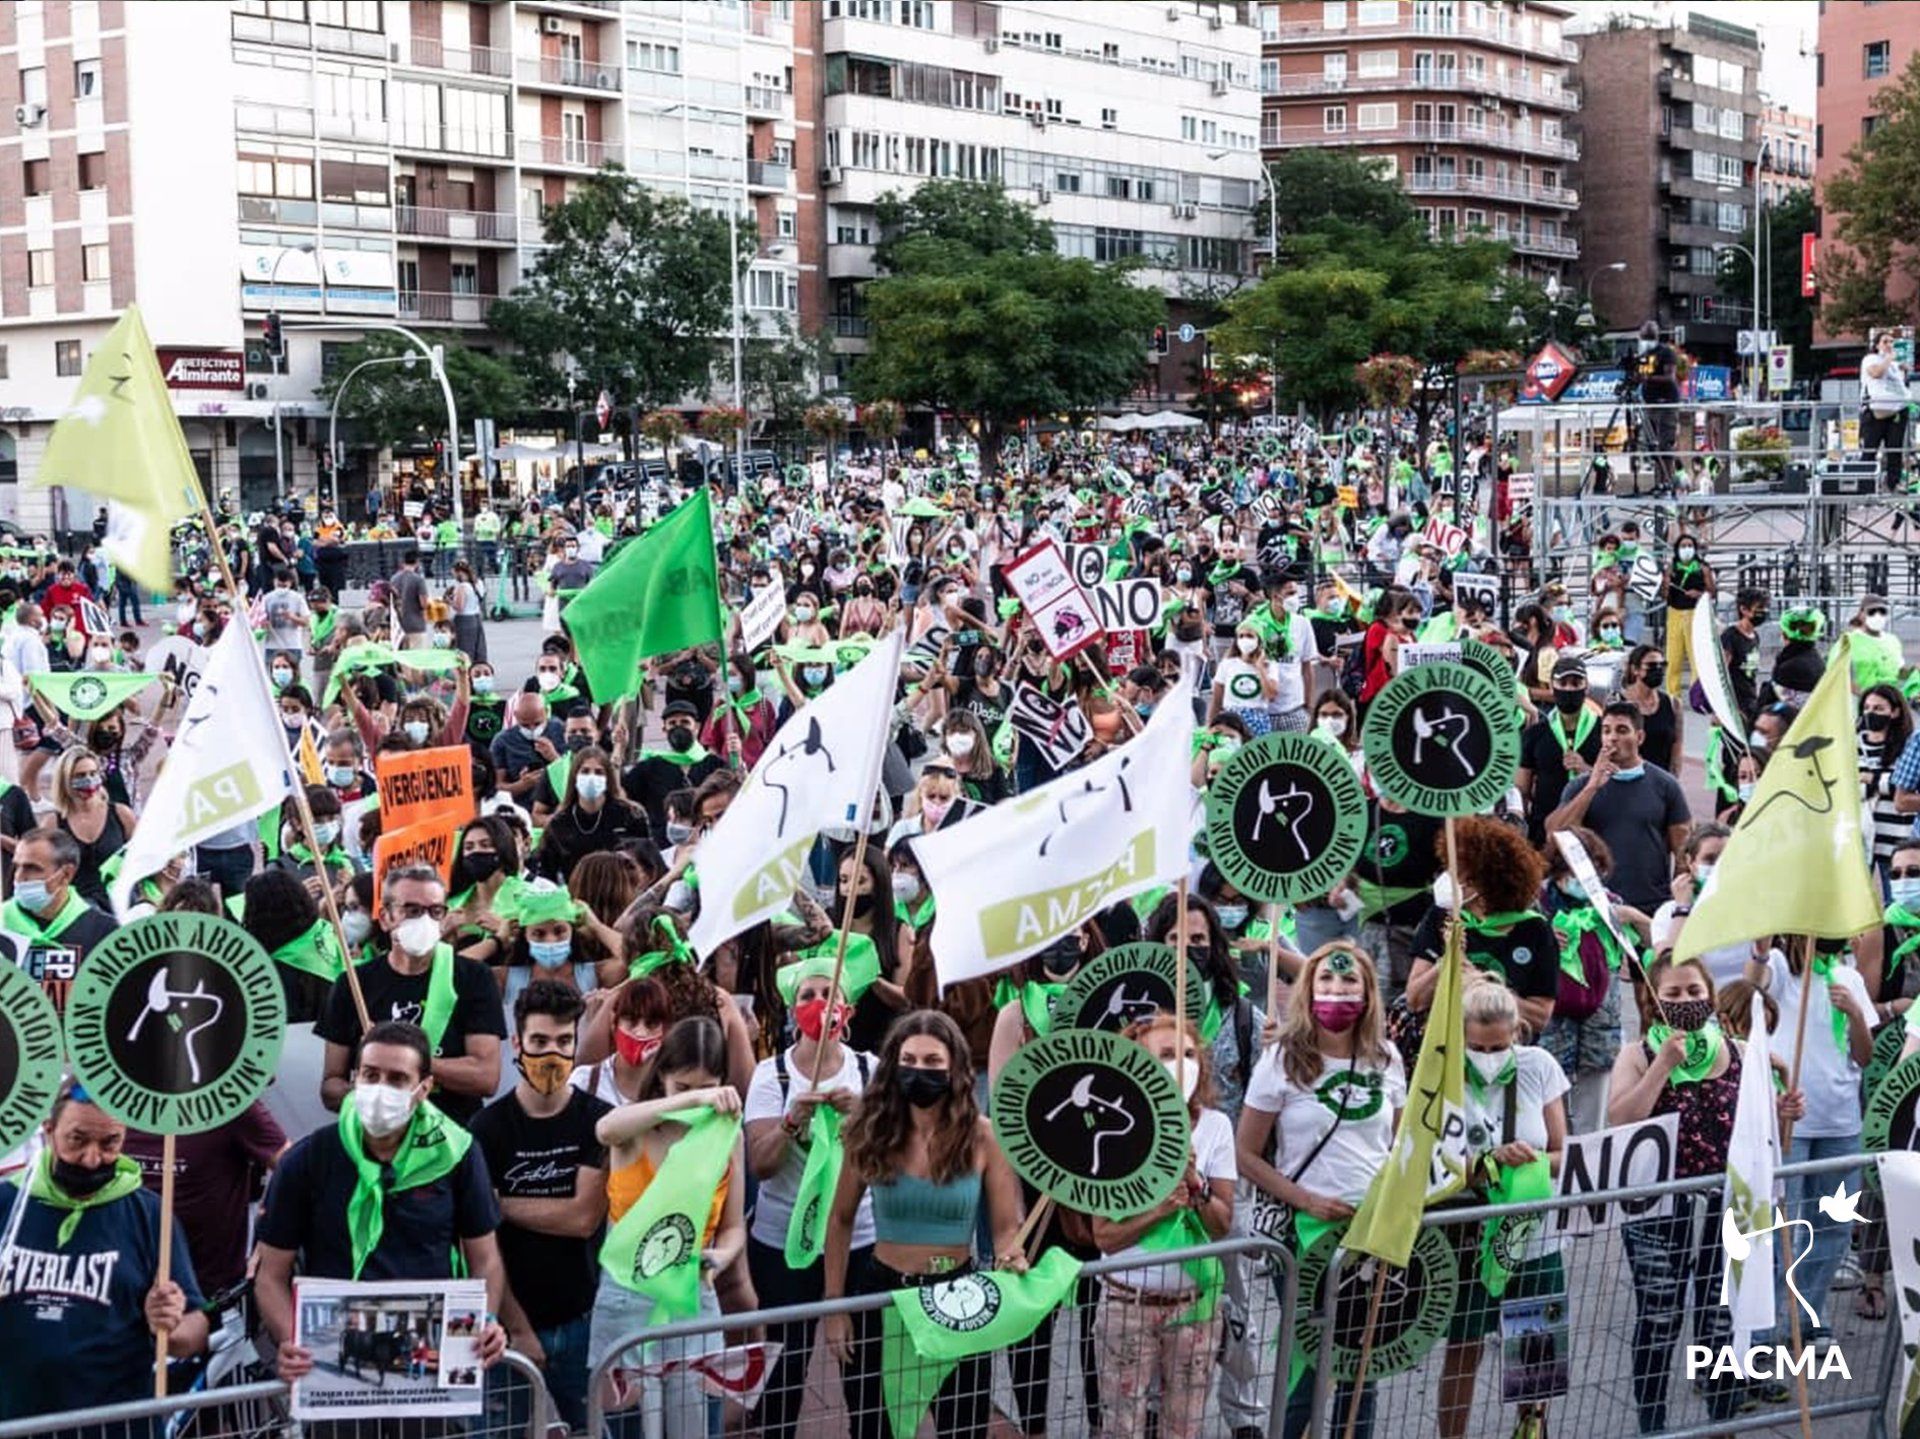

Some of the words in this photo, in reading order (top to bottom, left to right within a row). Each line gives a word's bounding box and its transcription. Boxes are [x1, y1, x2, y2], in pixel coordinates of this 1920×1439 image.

[166, 358, 240, 382] Almirante
[1427, 518, 1463, 555] NO
[1095, 580, 1160, 628] NO
[1456, 586, 1495, 617] NO
[382, 764, 463, 817] ¡VERGÜENZA!
[1556, 1123, 1671, 1230] NO
[0, 1243, 119, 1307] EVERLAST
